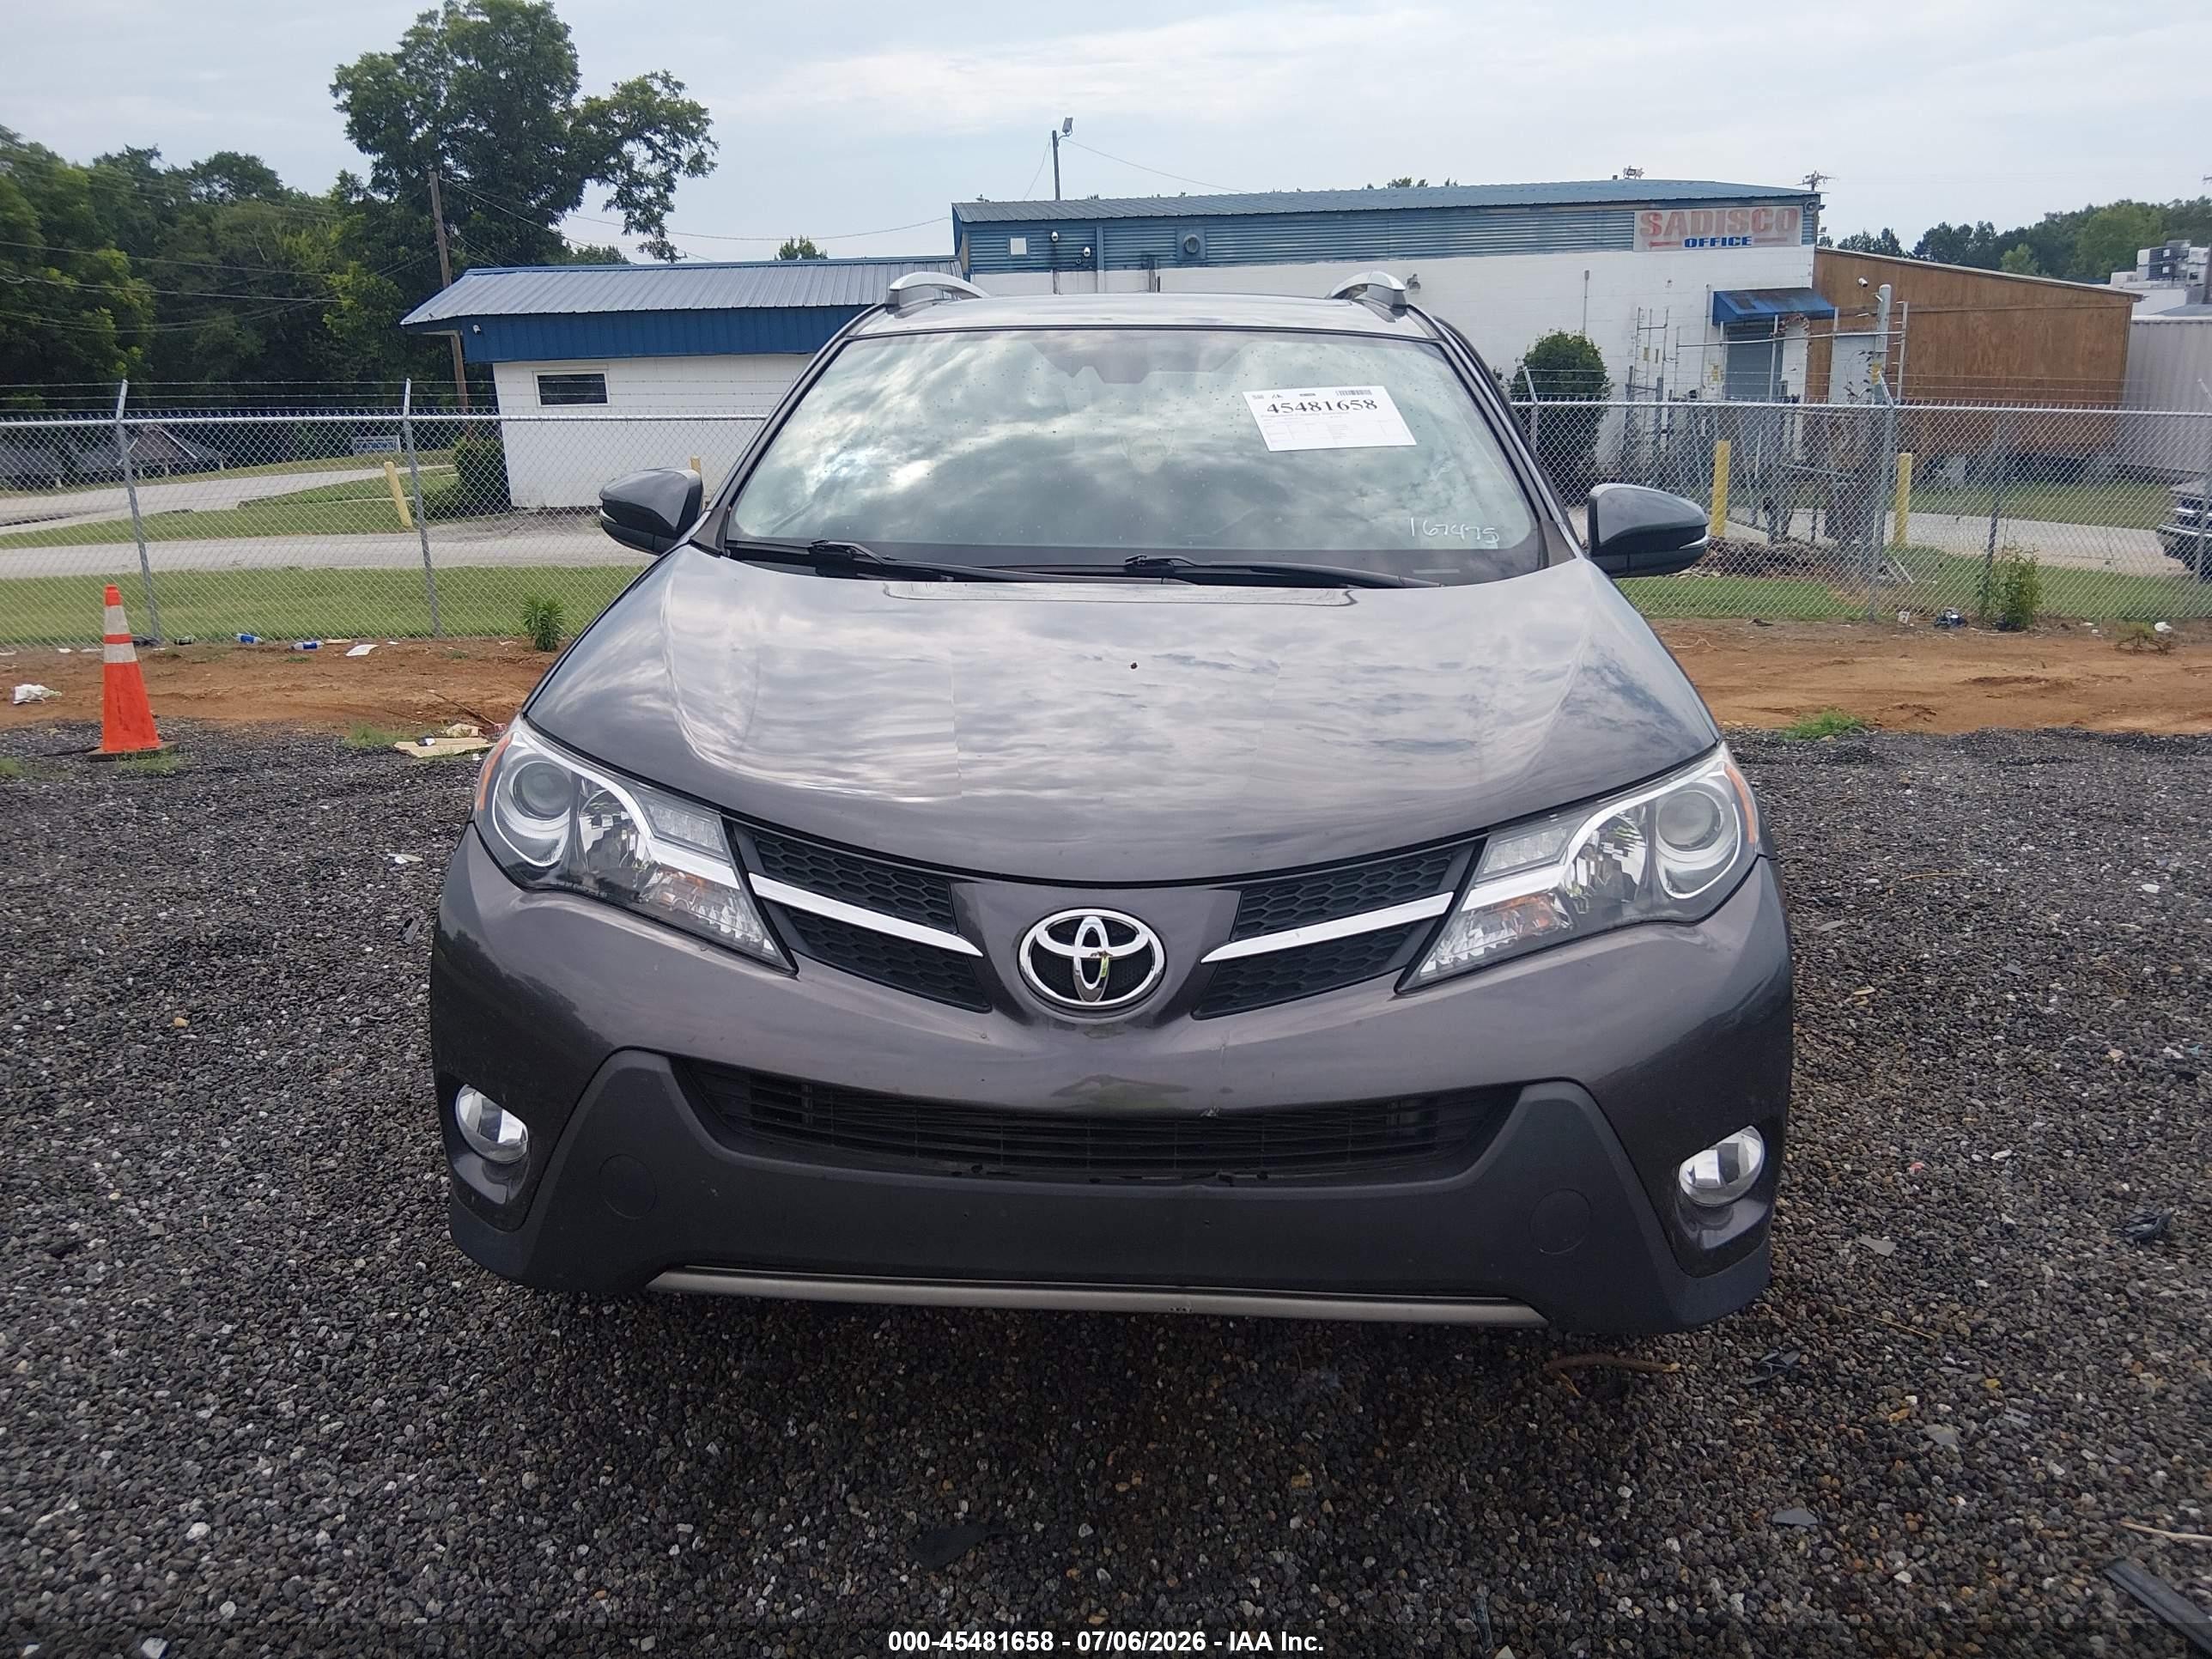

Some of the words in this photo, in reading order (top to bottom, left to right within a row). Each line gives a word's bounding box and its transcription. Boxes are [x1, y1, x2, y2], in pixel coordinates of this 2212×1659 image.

[1638, 208, 1799, 236] SADISCO
[1684, 236, 1753, 248] OFFICE
[1267, 398, 1378, 414] 45481658
[1410, 517, 1499, 544] 167475
